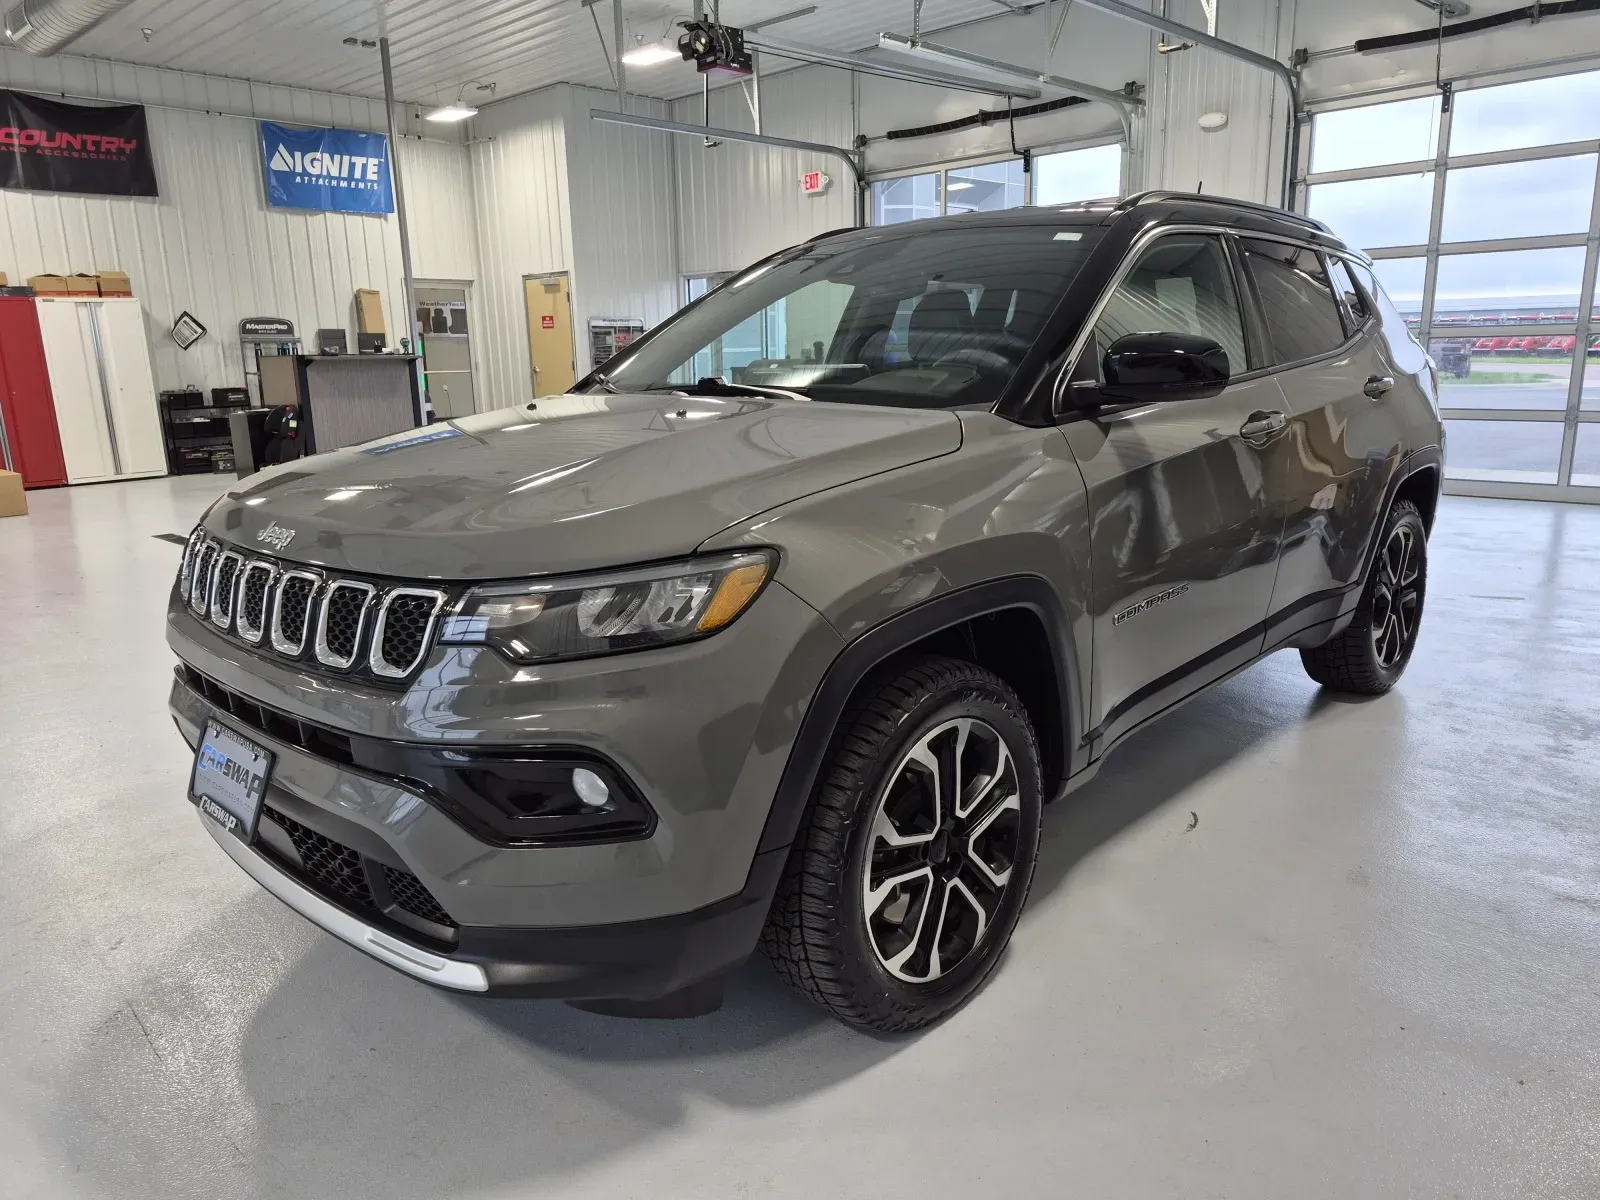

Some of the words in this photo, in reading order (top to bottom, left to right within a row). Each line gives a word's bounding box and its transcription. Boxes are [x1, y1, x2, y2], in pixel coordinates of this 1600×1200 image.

[0, 127, 137, 153] COUNTRY
[1, 145, 27, 153] AND
[36, 148, 126, 161] ACCESSORIES
[294, 151, 379, 180] IGNITE
[295, 175, 379, 190] ATTACHMENTS
[804, 172, 819, 190] EXIT
[257, 520, 296, 550] Jeep
[1112, 582, 1190, 626] COMPASS
[198, 742, 265, 799] CARSWAP
[200, 795, 237, 831] CARSWAP
